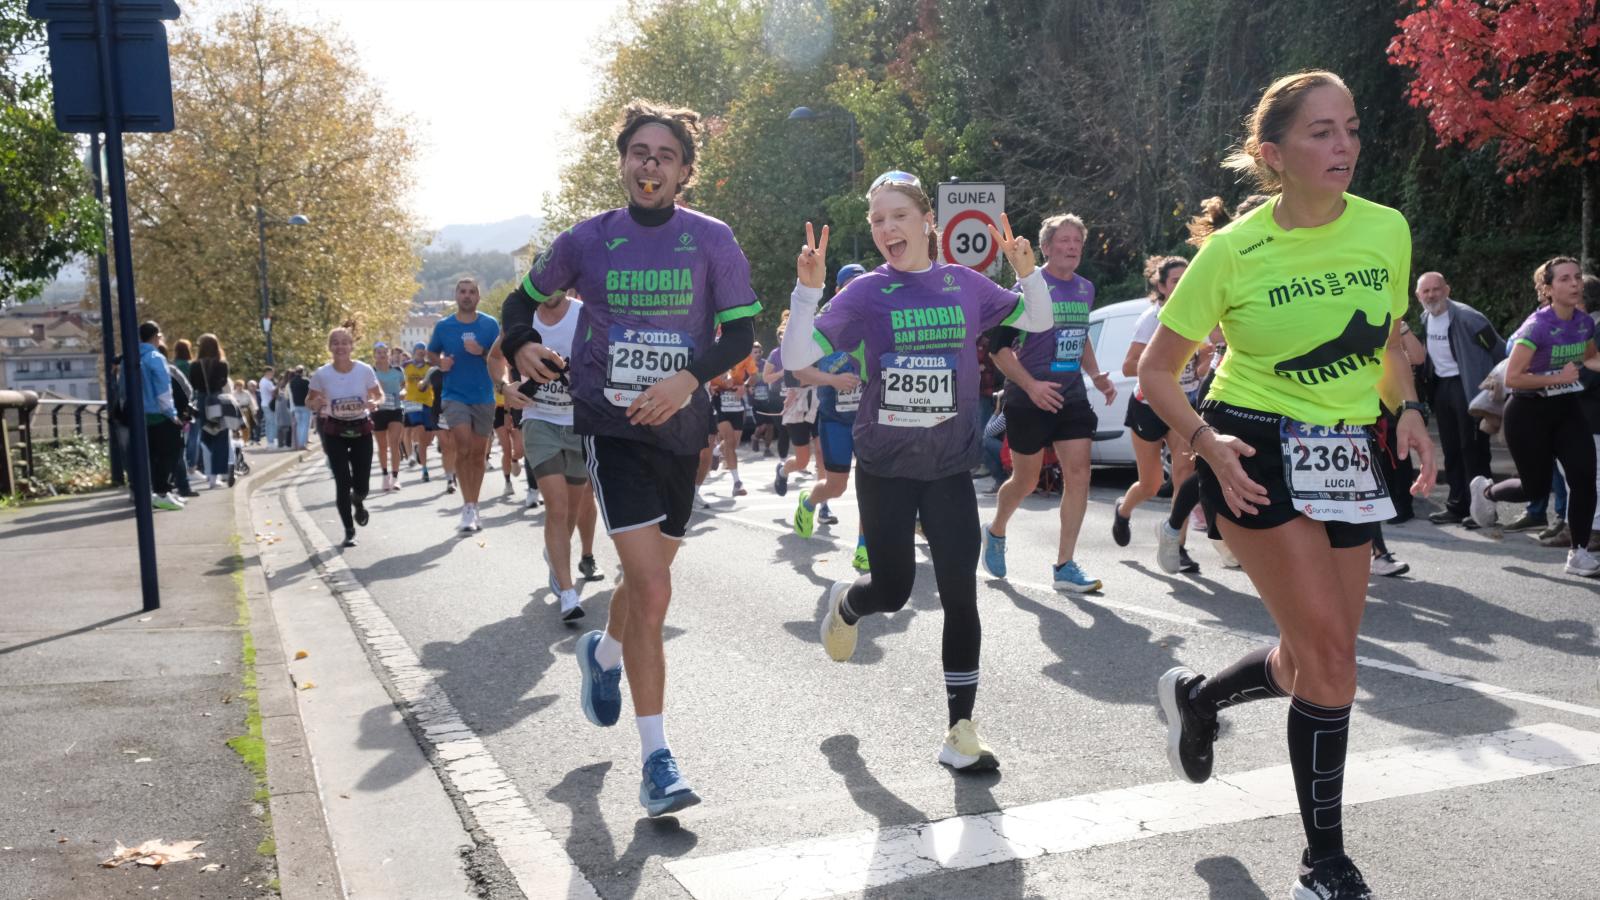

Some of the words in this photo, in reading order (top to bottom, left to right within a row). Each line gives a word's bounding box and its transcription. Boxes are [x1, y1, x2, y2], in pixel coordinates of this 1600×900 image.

[947, 192, 996, 204] GUNEA
[956, 232, 987, 254] 30
[606, 268, 693, 292] BEHOBIA
[1344, 267, 1389, 291] auga
[607, 293, 629, 306] SAN
[890, 305, 966, 330] BEHOBIA
[894, 330, 916, 344] SAN
[614, 348, 687, 372] 28500
[636, 375, 664, 384] ENEKO
[887, 373, 949, 393] 28501
